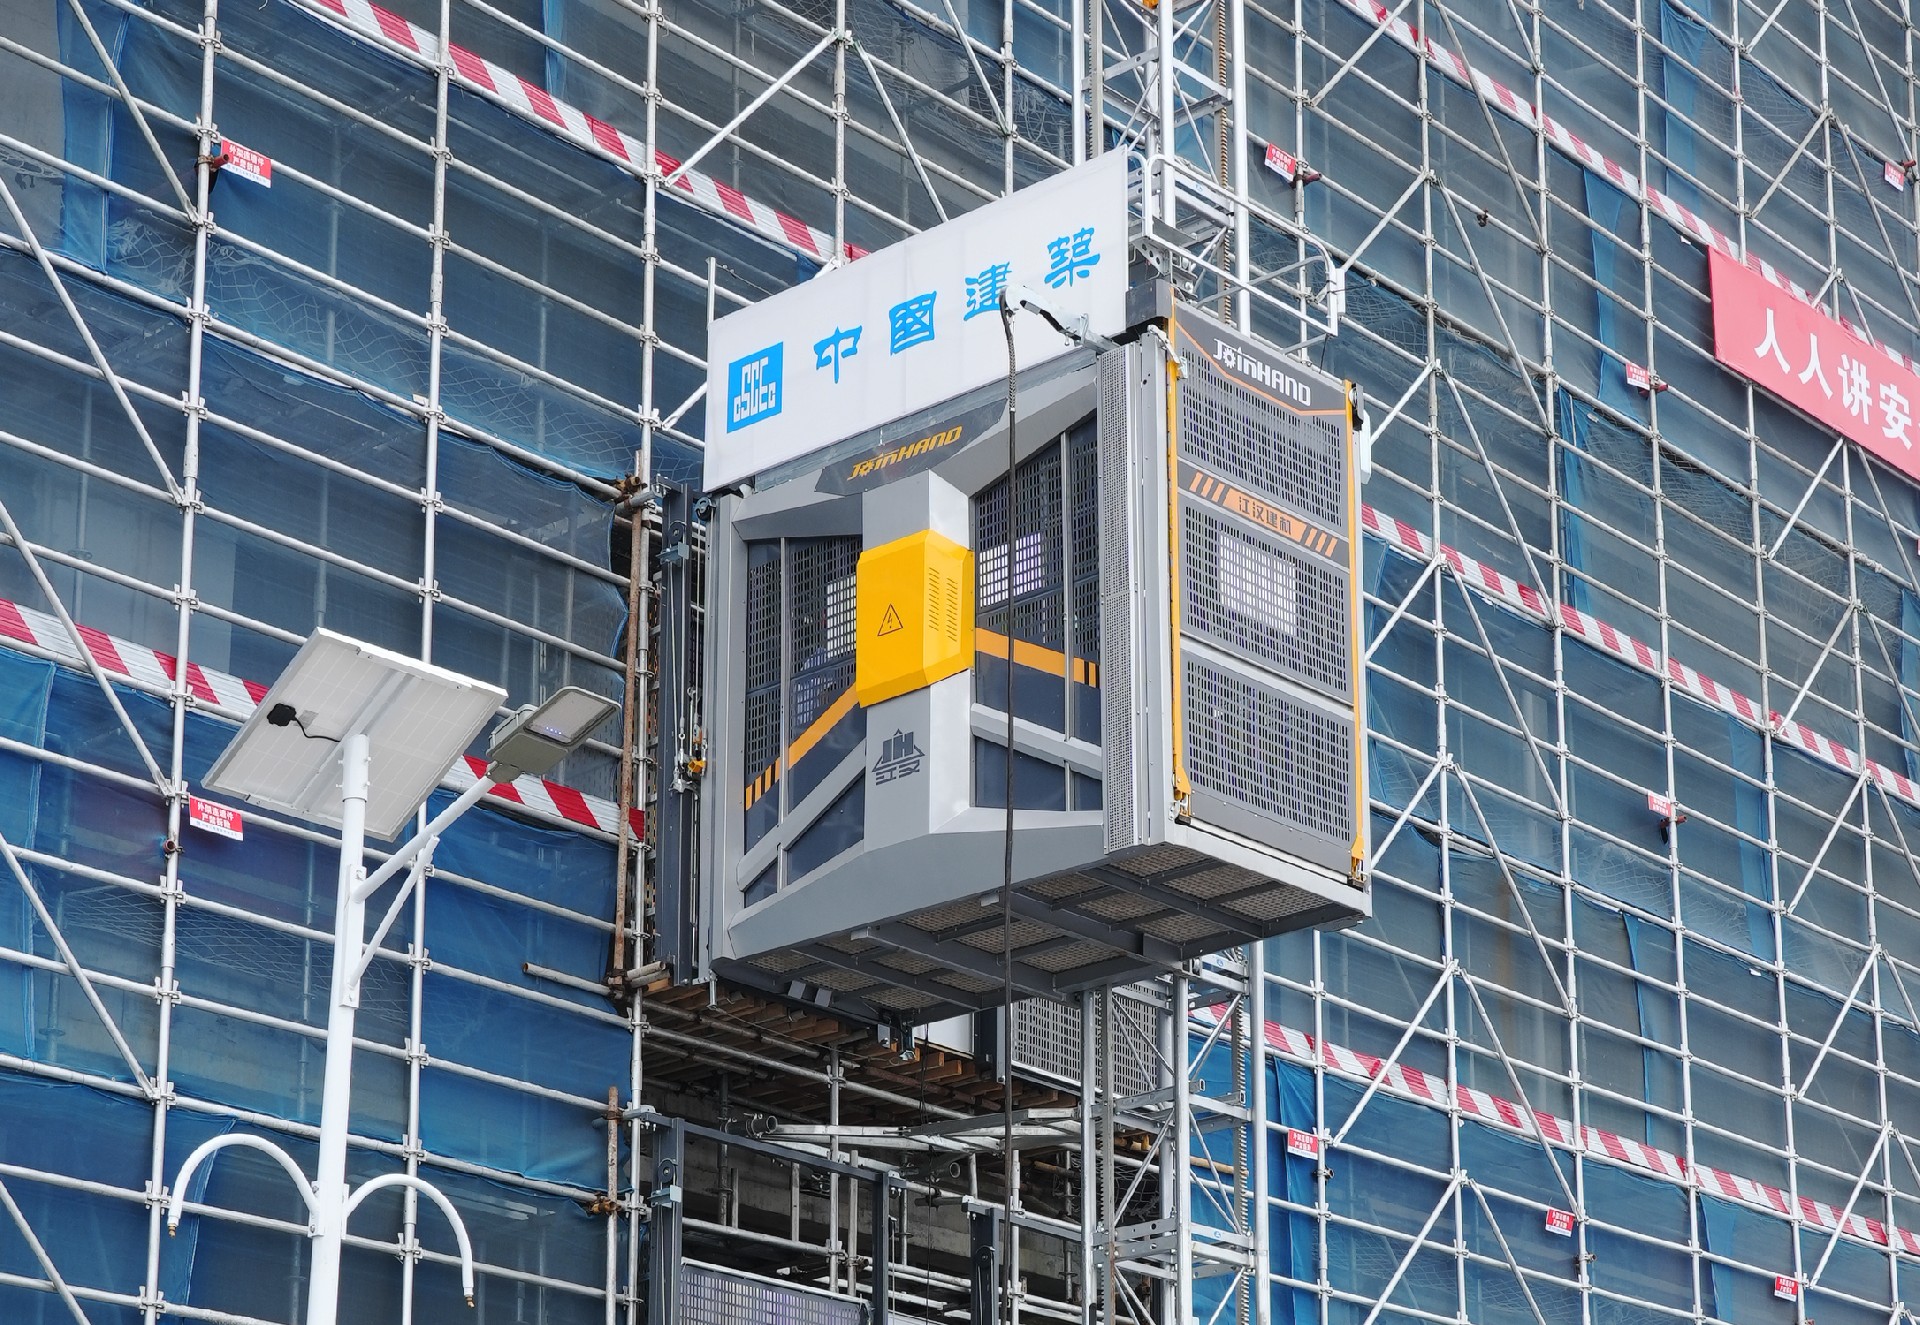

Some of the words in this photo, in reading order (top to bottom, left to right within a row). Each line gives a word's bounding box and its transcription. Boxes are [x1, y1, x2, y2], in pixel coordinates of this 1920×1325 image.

[1754, 307, 1920, 450] 人人讲安
[1239, 496, 1292, 535] 江汉建机
